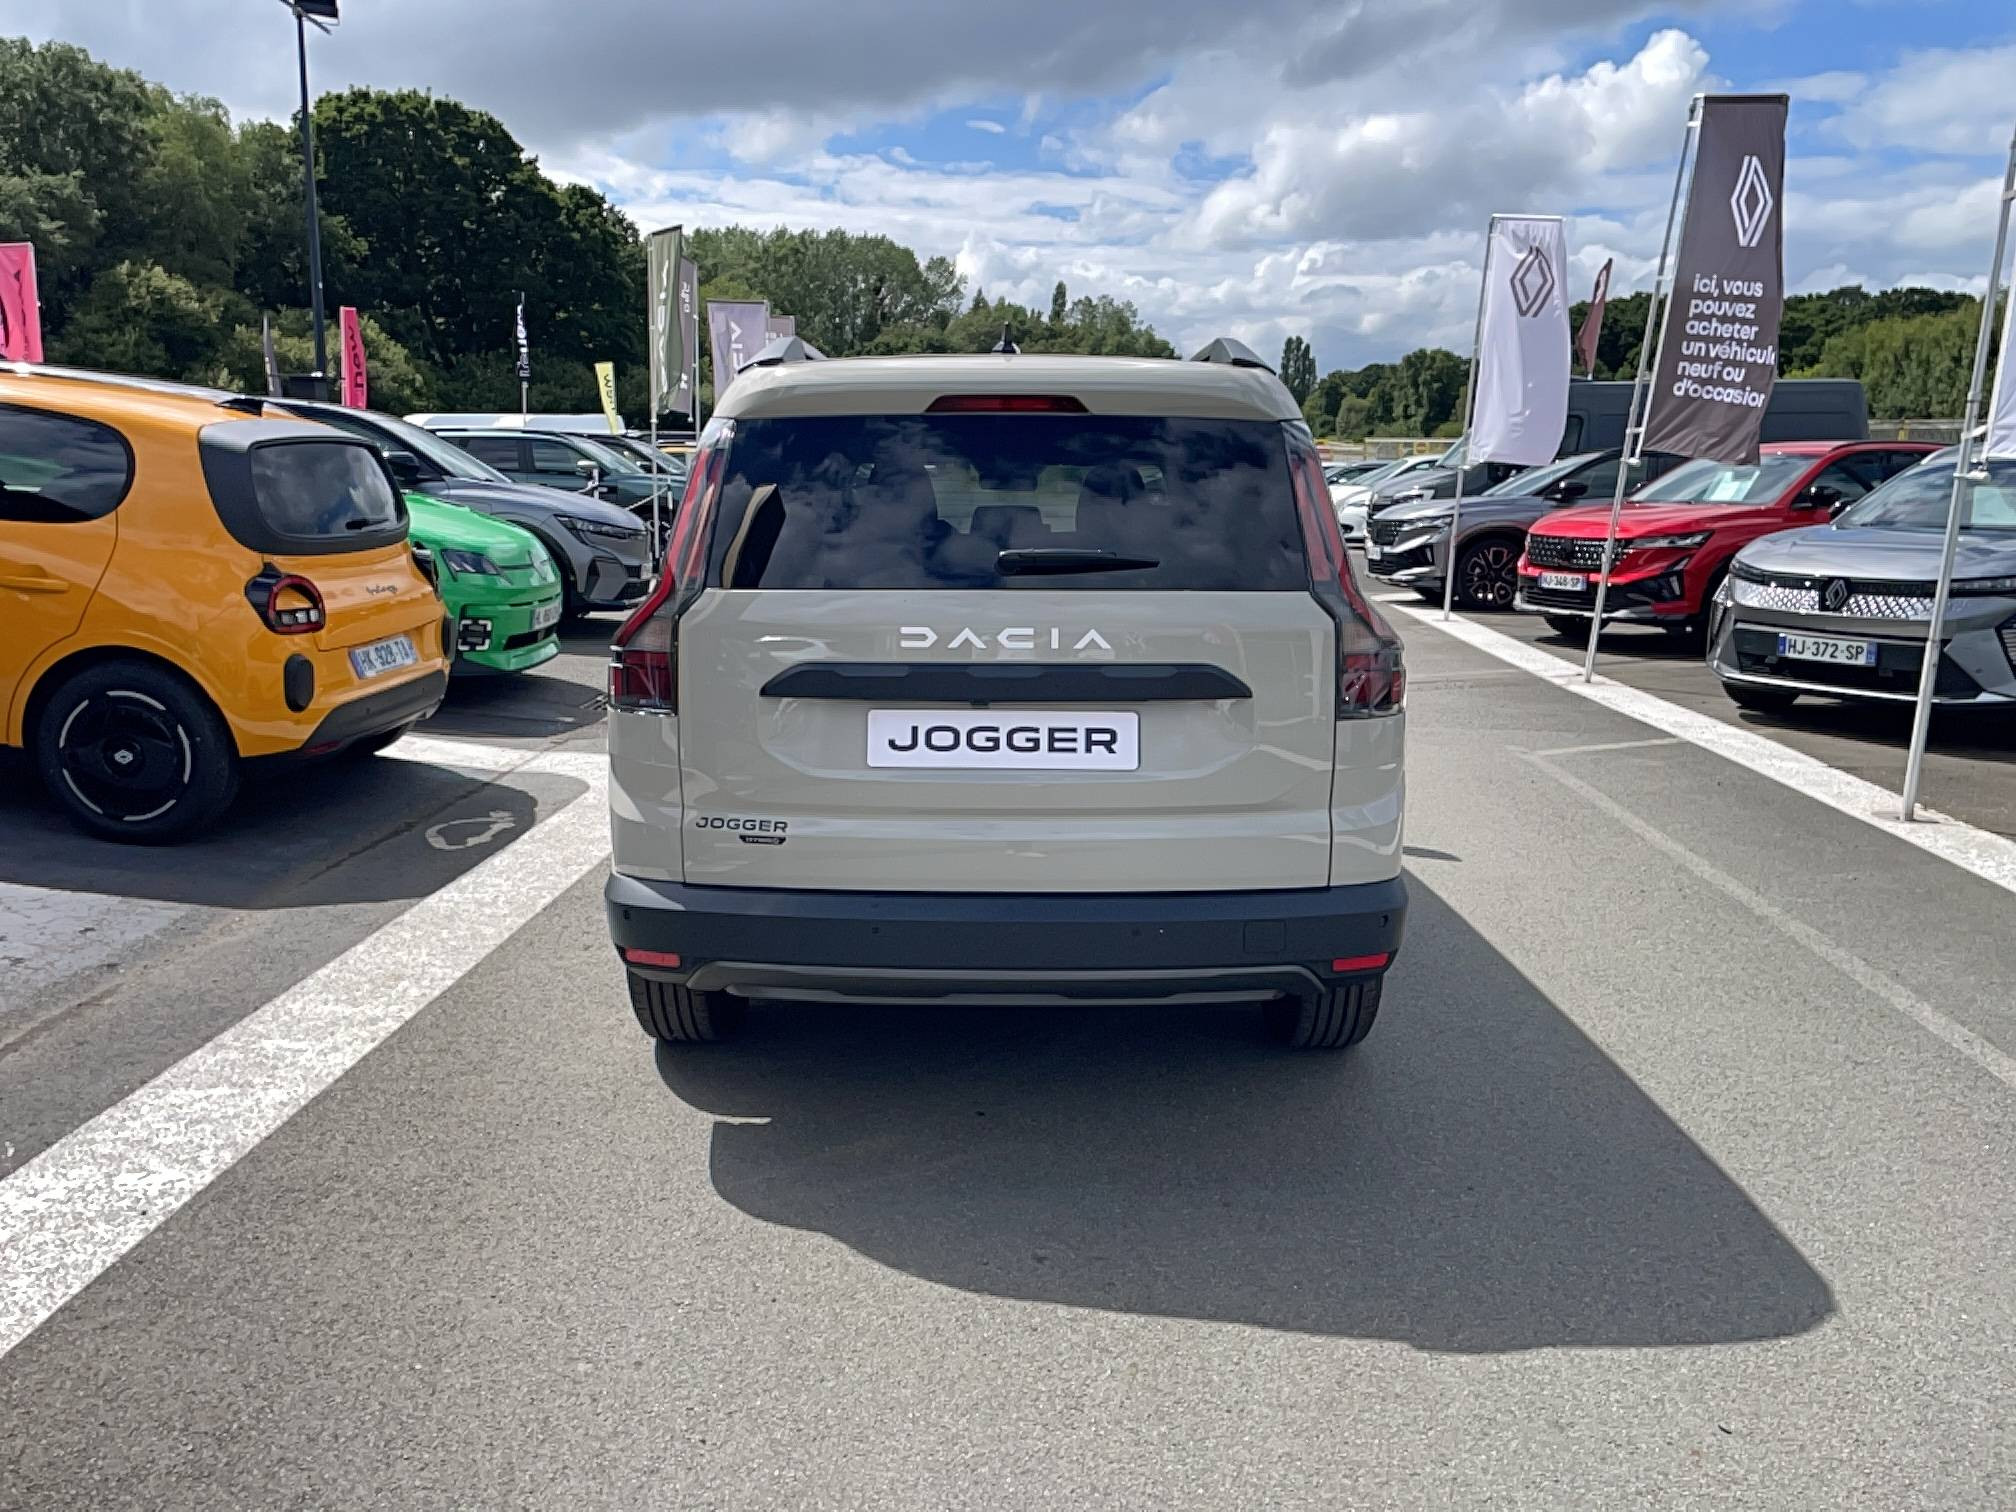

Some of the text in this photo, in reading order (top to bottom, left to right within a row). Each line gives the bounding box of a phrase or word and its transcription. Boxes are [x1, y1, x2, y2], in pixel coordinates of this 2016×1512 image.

[1693, 273, 1764, 297] ici, vous
[1688, 298, 1756, 319] pouvez
[1685, 317, 1759, 341] acheter
[1681, 340, 1706, 356] un
[1677, 361, 1746, 383] neuf ou
[900, 626, 1112, 649] DACIA
[1787, 638, 1865, 661] HJ-372-SP
[888, 724, 1118, 754] JOGGER
[695, 816, 789, 833] JOGGER
